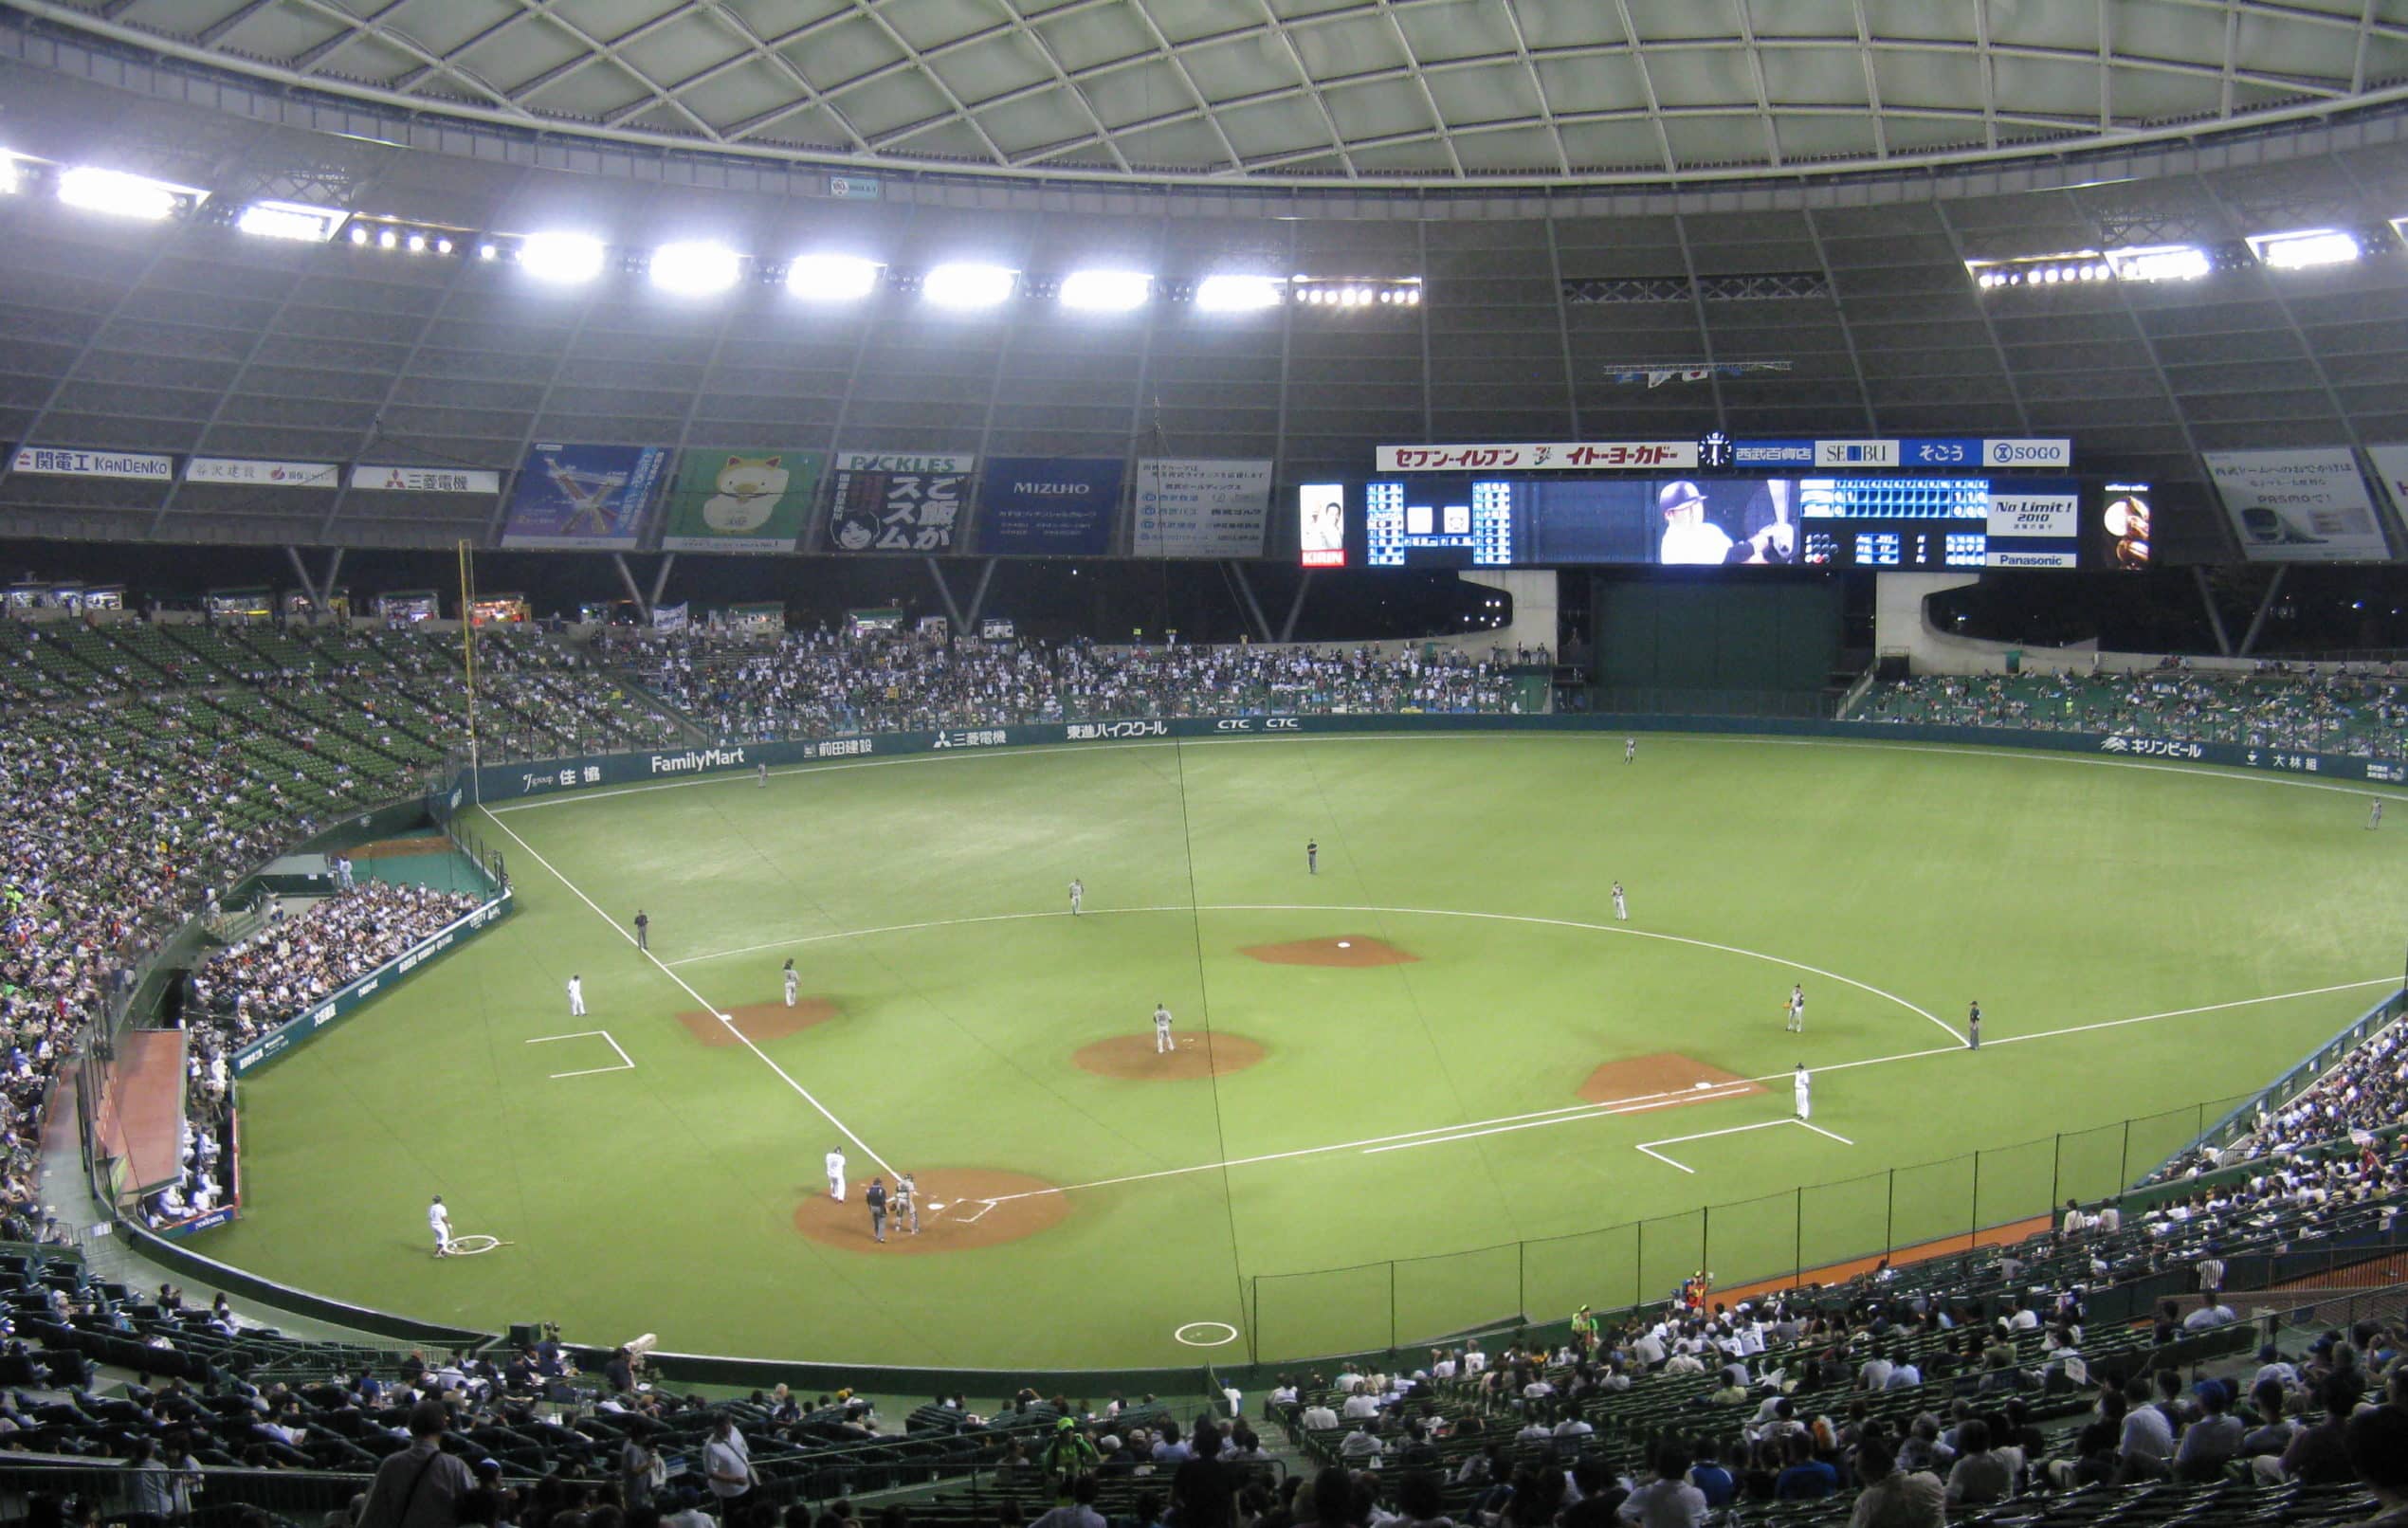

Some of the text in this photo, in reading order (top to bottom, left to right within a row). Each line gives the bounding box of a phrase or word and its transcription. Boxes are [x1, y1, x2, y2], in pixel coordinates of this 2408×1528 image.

[35, 450, 90, 472] 関電工
[1566, 446, 1678, 465] イトーヨーカドー
[1736, 446, 1812, 461] 西武百貨店
[1826, 445, 1886, 462] SEIBU
[1919, 445, 1963, 462] そごう
[2015, 446, 2060, 460] SOGO
[407, 473, 468, 492] 三菱電機
[1013, 482, 1089, 494] MIZUHO
[1996, 501, 2016, 513] No
[2017, 514, 2050, 522] 2010
[1303, 552, 1343, 565] KIRIN
[2000, 554, 2062, 566] Panasonic
[1067, 720, 1167, 740] 東進ハイスクール
[1217, 719, 1251, 729] CTC
[1266, 718, 1300, 728] CTC
[818, 738, 873, 756] 前田建設
[952, 730, 1007, 747] 三菱電機
[2131, 739, 2201, 758] キリンビール
[651, 747, 744, 773] FamilyMart
[2273, 755, 2317, 772] 大林組
